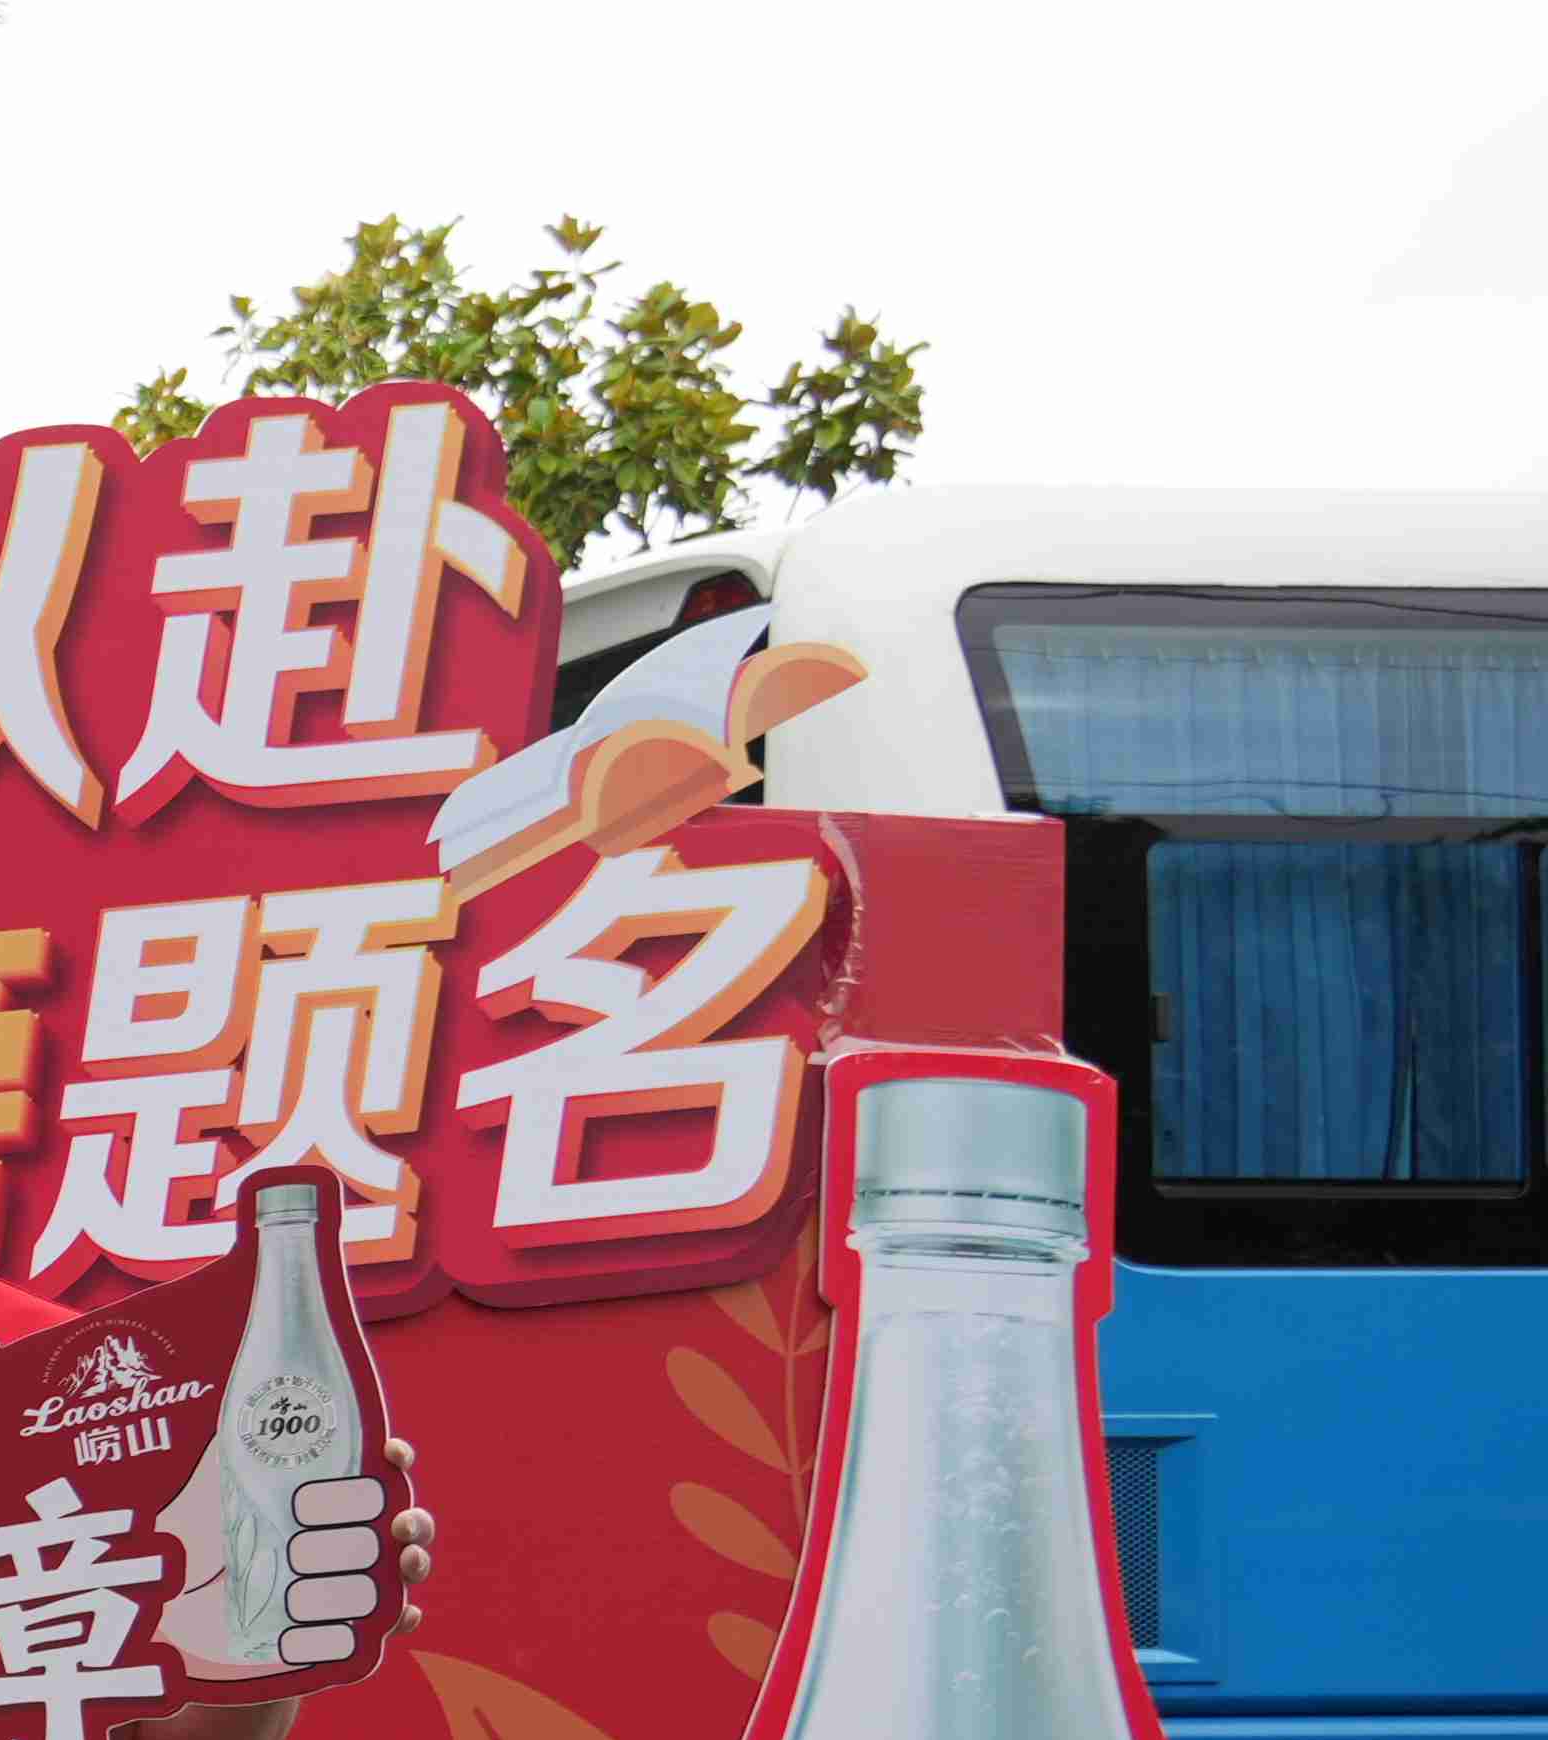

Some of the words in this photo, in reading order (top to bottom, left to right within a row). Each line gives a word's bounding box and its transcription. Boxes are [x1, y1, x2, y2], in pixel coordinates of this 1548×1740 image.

[20, 1379, 214, 1437] Laoshan
[257, 1414, 321, 1441] 1900
[73, 1416, 171, 1467] 崂山
